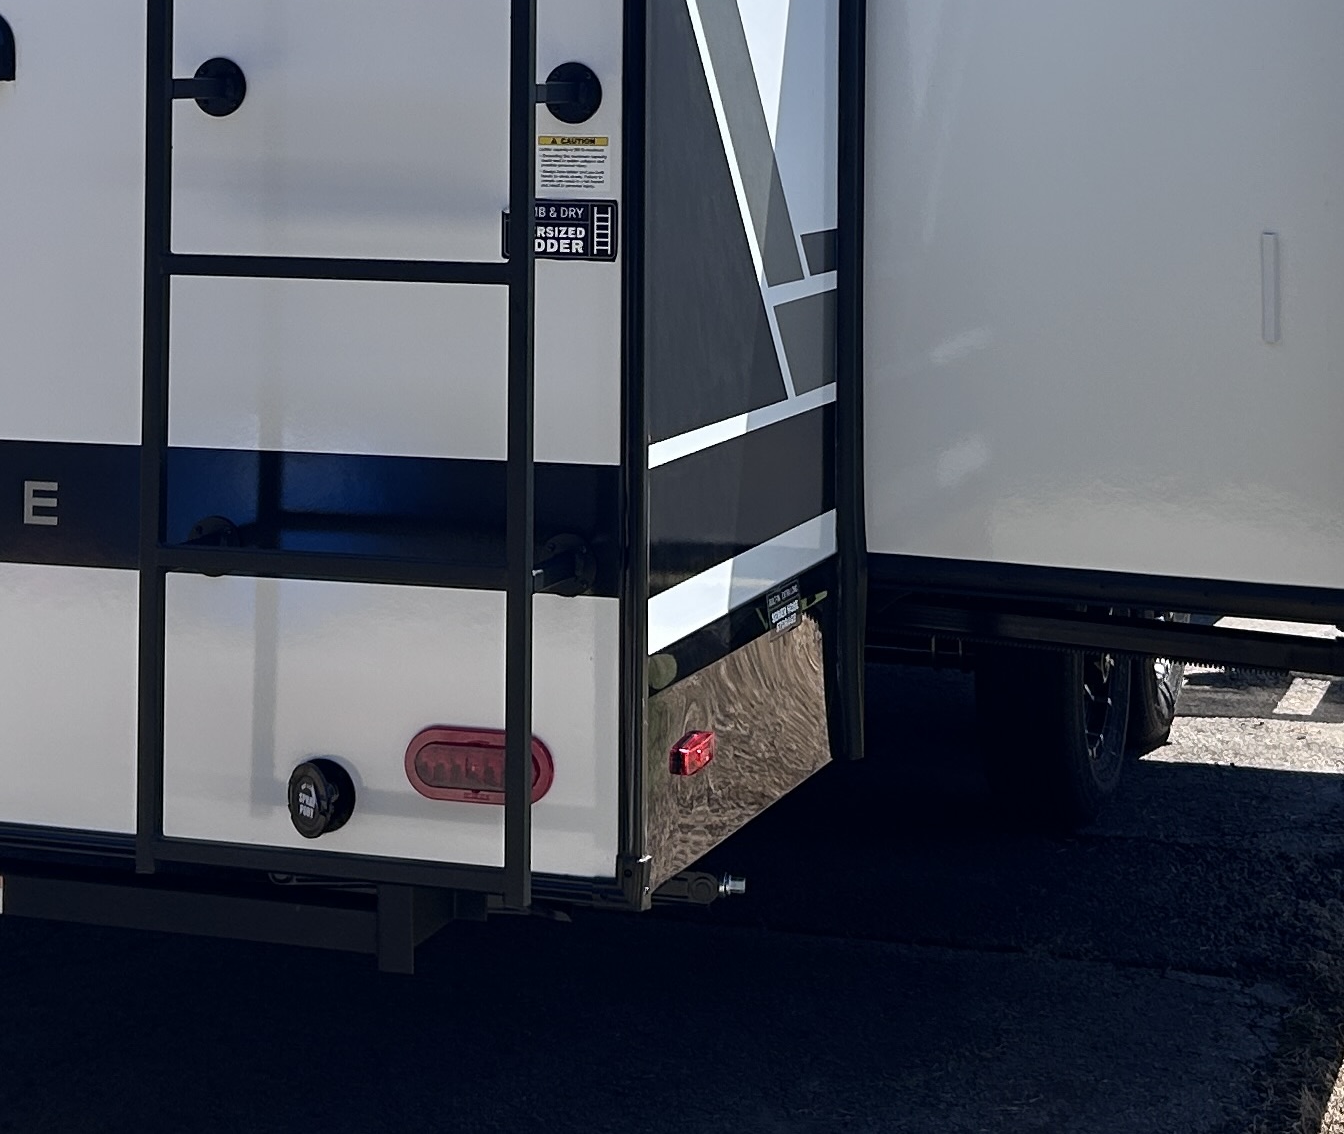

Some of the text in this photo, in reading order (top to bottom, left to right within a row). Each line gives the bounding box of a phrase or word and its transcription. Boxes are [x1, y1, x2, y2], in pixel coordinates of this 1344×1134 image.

[560, 137, 596, 145] CAUTION
[560, 206, 584, 219] DRY
[536, 226, 586, 238] RSIZED
[534, 238, 584, 253] DDER
